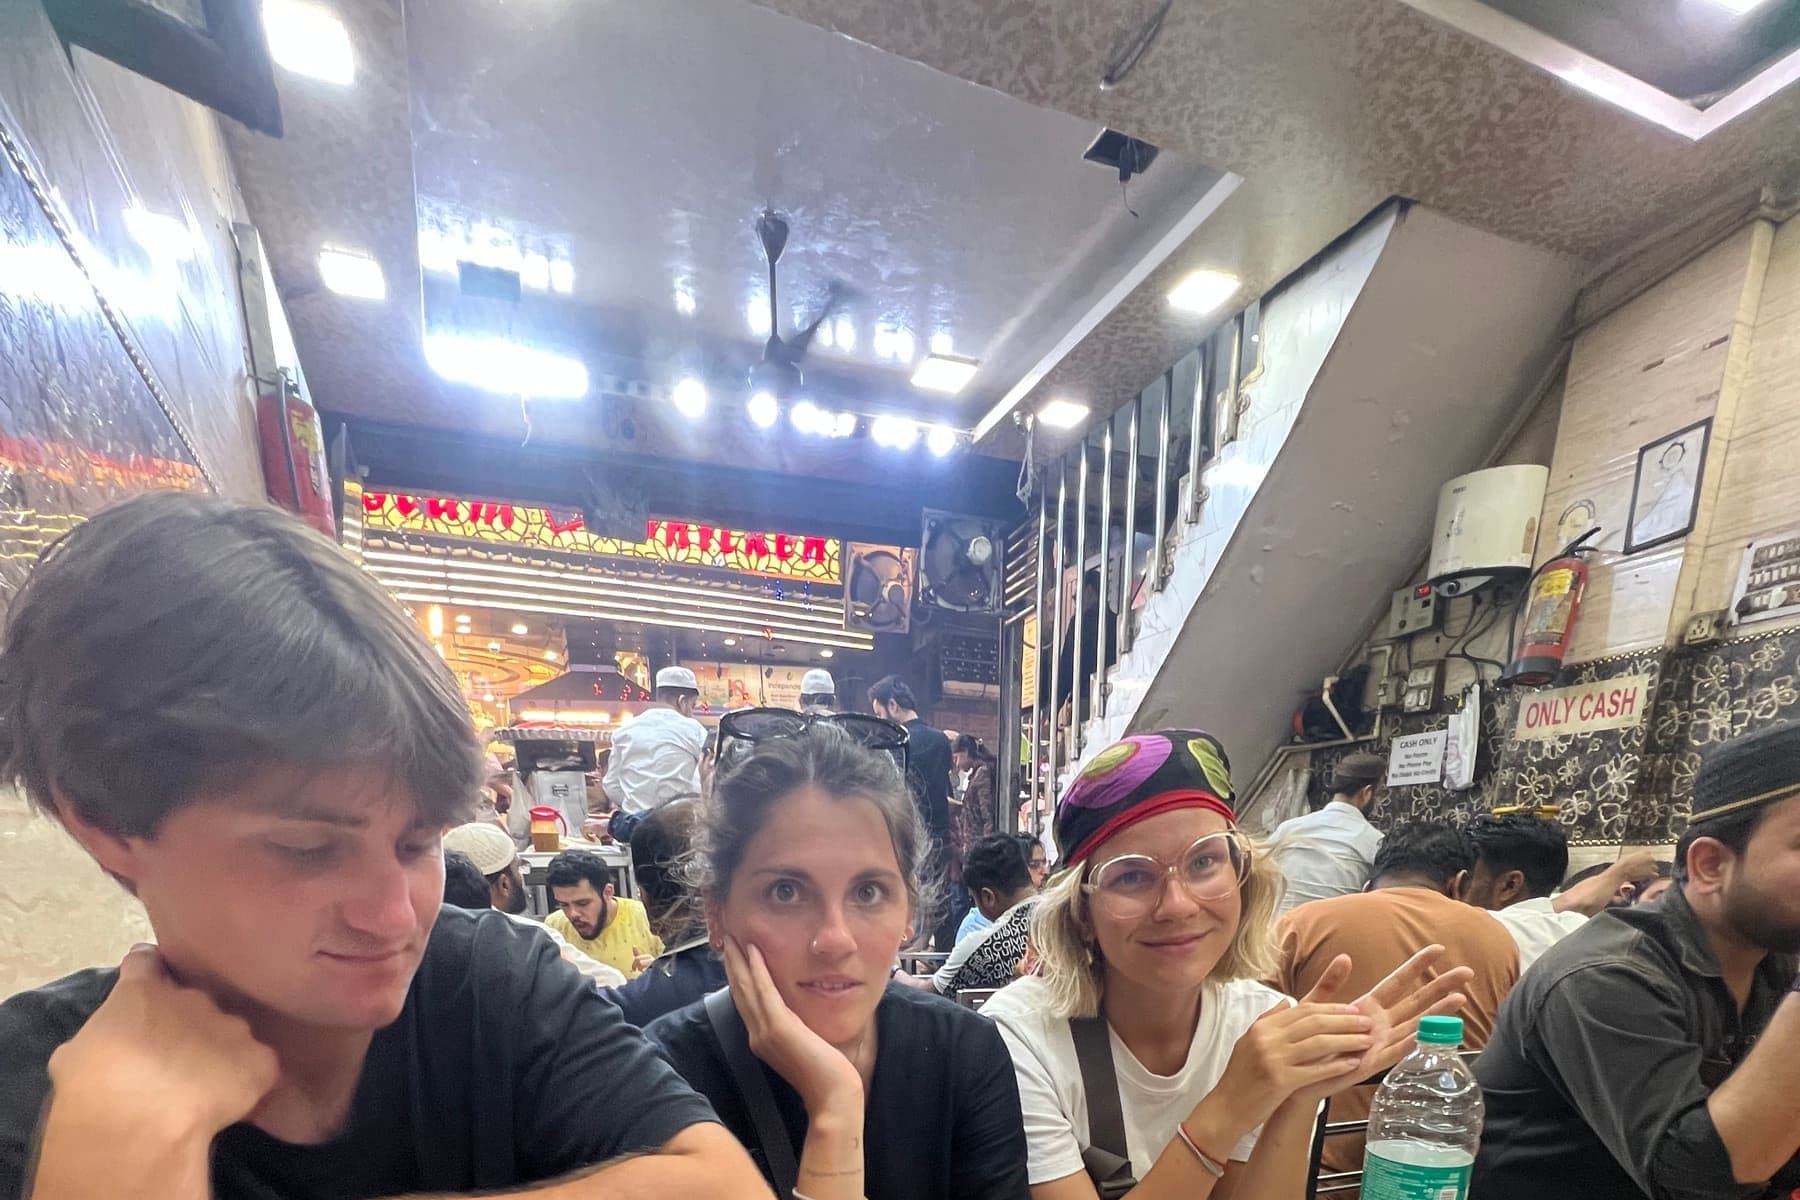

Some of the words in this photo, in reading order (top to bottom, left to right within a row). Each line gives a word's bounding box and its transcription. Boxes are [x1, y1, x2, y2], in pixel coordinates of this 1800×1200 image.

[1526, 696, 1576, 729] ONLY
[1580, 686, 1638, 722] CASH
[1400, 739, 1418, 749] CASH
[1419, 737, 1438, 746] ONLY
